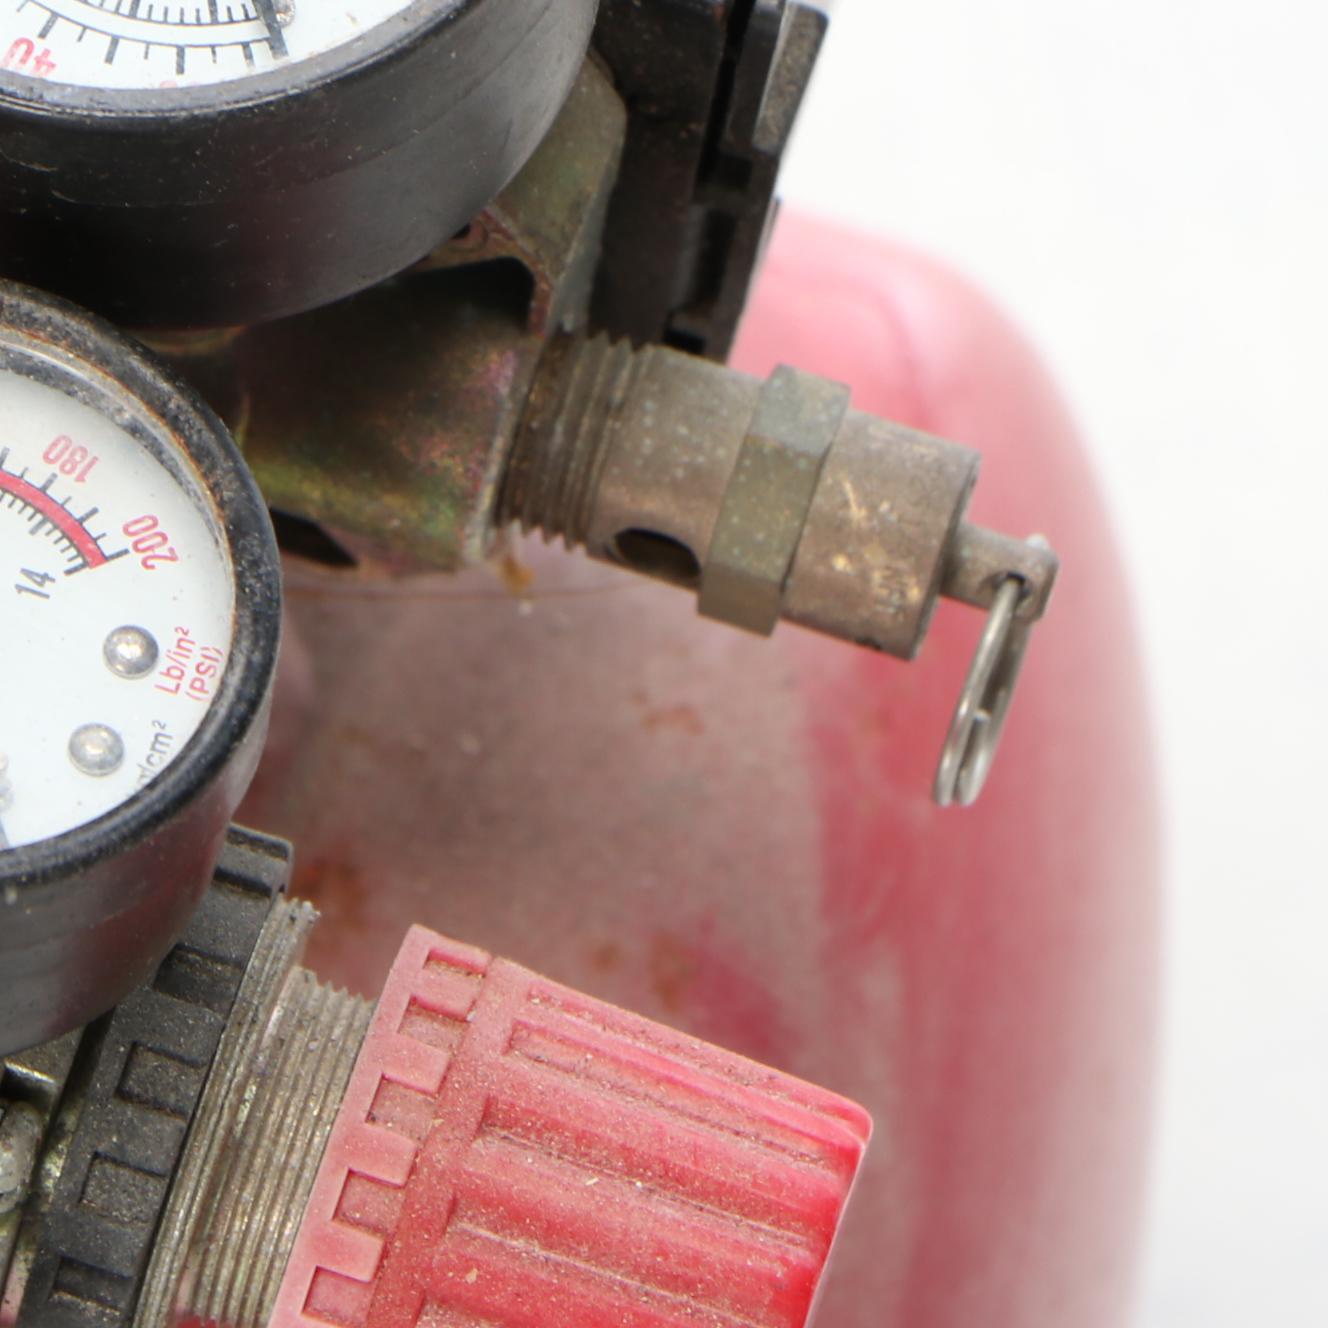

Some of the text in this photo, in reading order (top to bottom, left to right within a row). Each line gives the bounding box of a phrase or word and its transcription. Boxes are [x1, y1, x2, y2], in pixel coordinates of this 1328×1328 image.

[42, 435, 99, 483] 180
[122, 514, 179, 570] 200
[14, 567, 56, 599] 14
[185, 645, 224, 702] (PSI)
